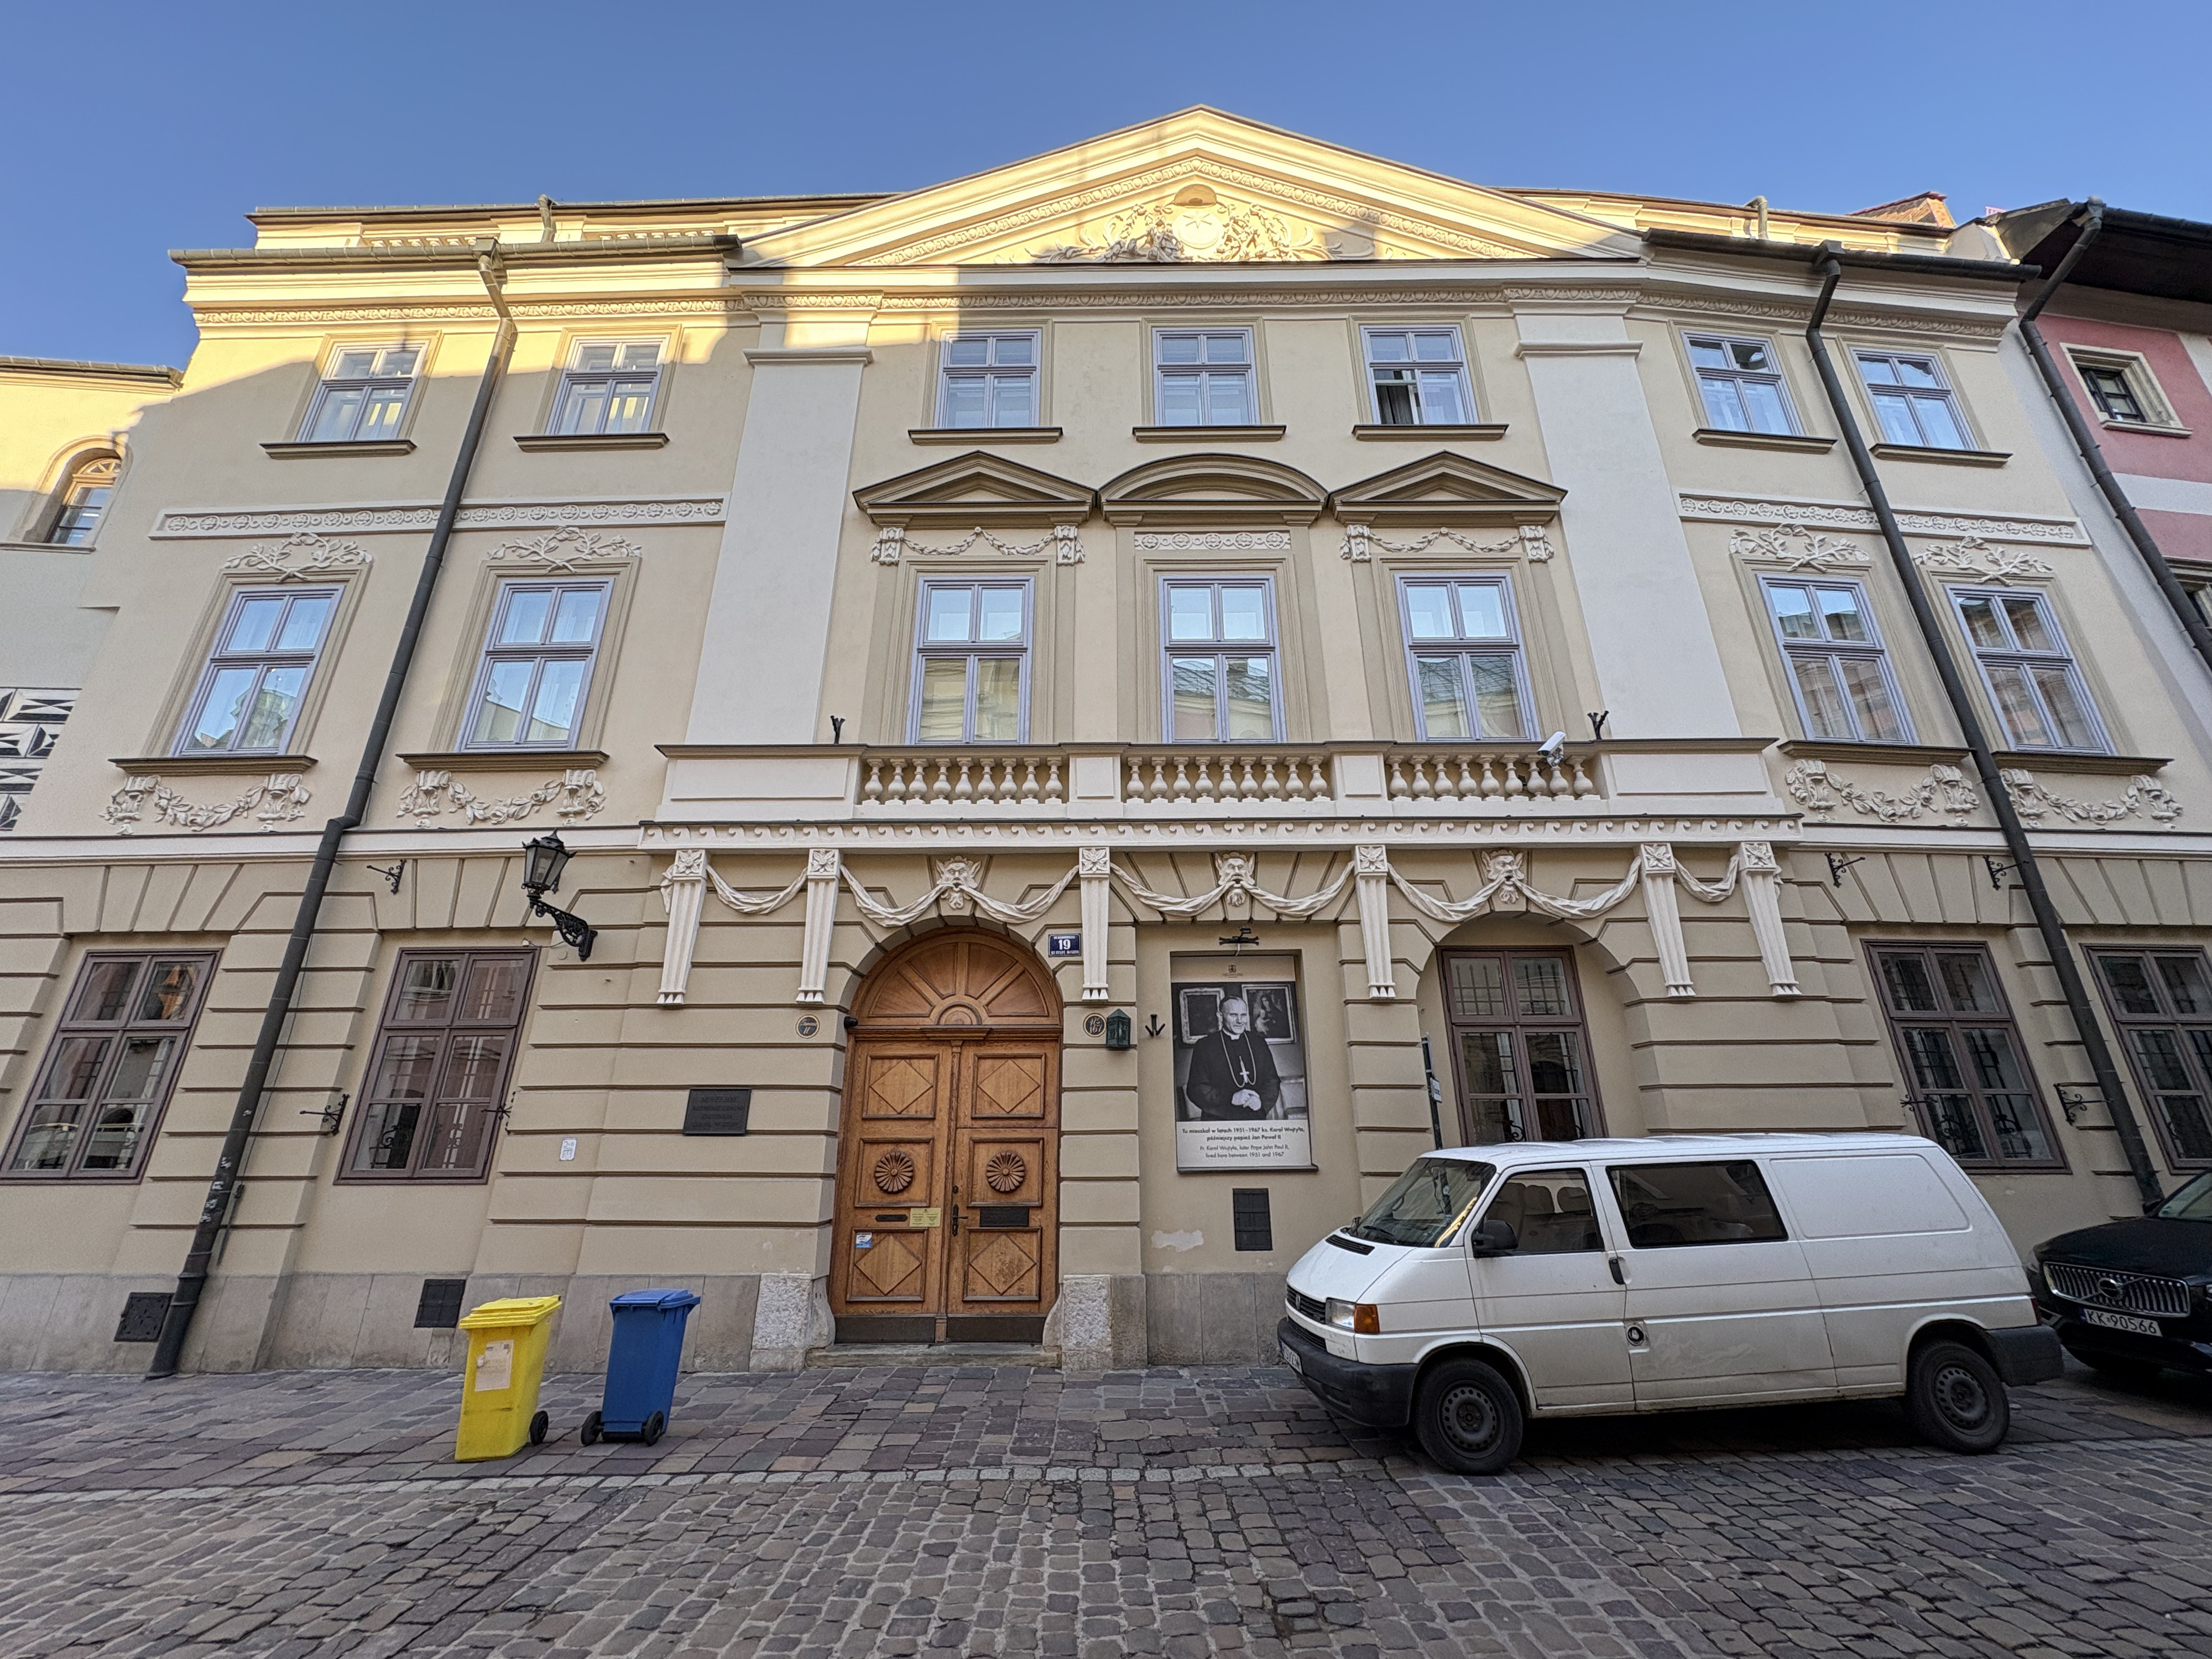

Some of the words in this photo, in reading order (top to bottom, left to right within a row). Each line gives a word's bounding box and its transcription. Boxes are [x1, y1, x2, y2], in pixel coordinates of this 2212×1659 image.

[1058, 939, 1071, 950] 19
[2086, 1310, 2107, 1326] KK
[2110, 1314, 2157, 1334] 90566
